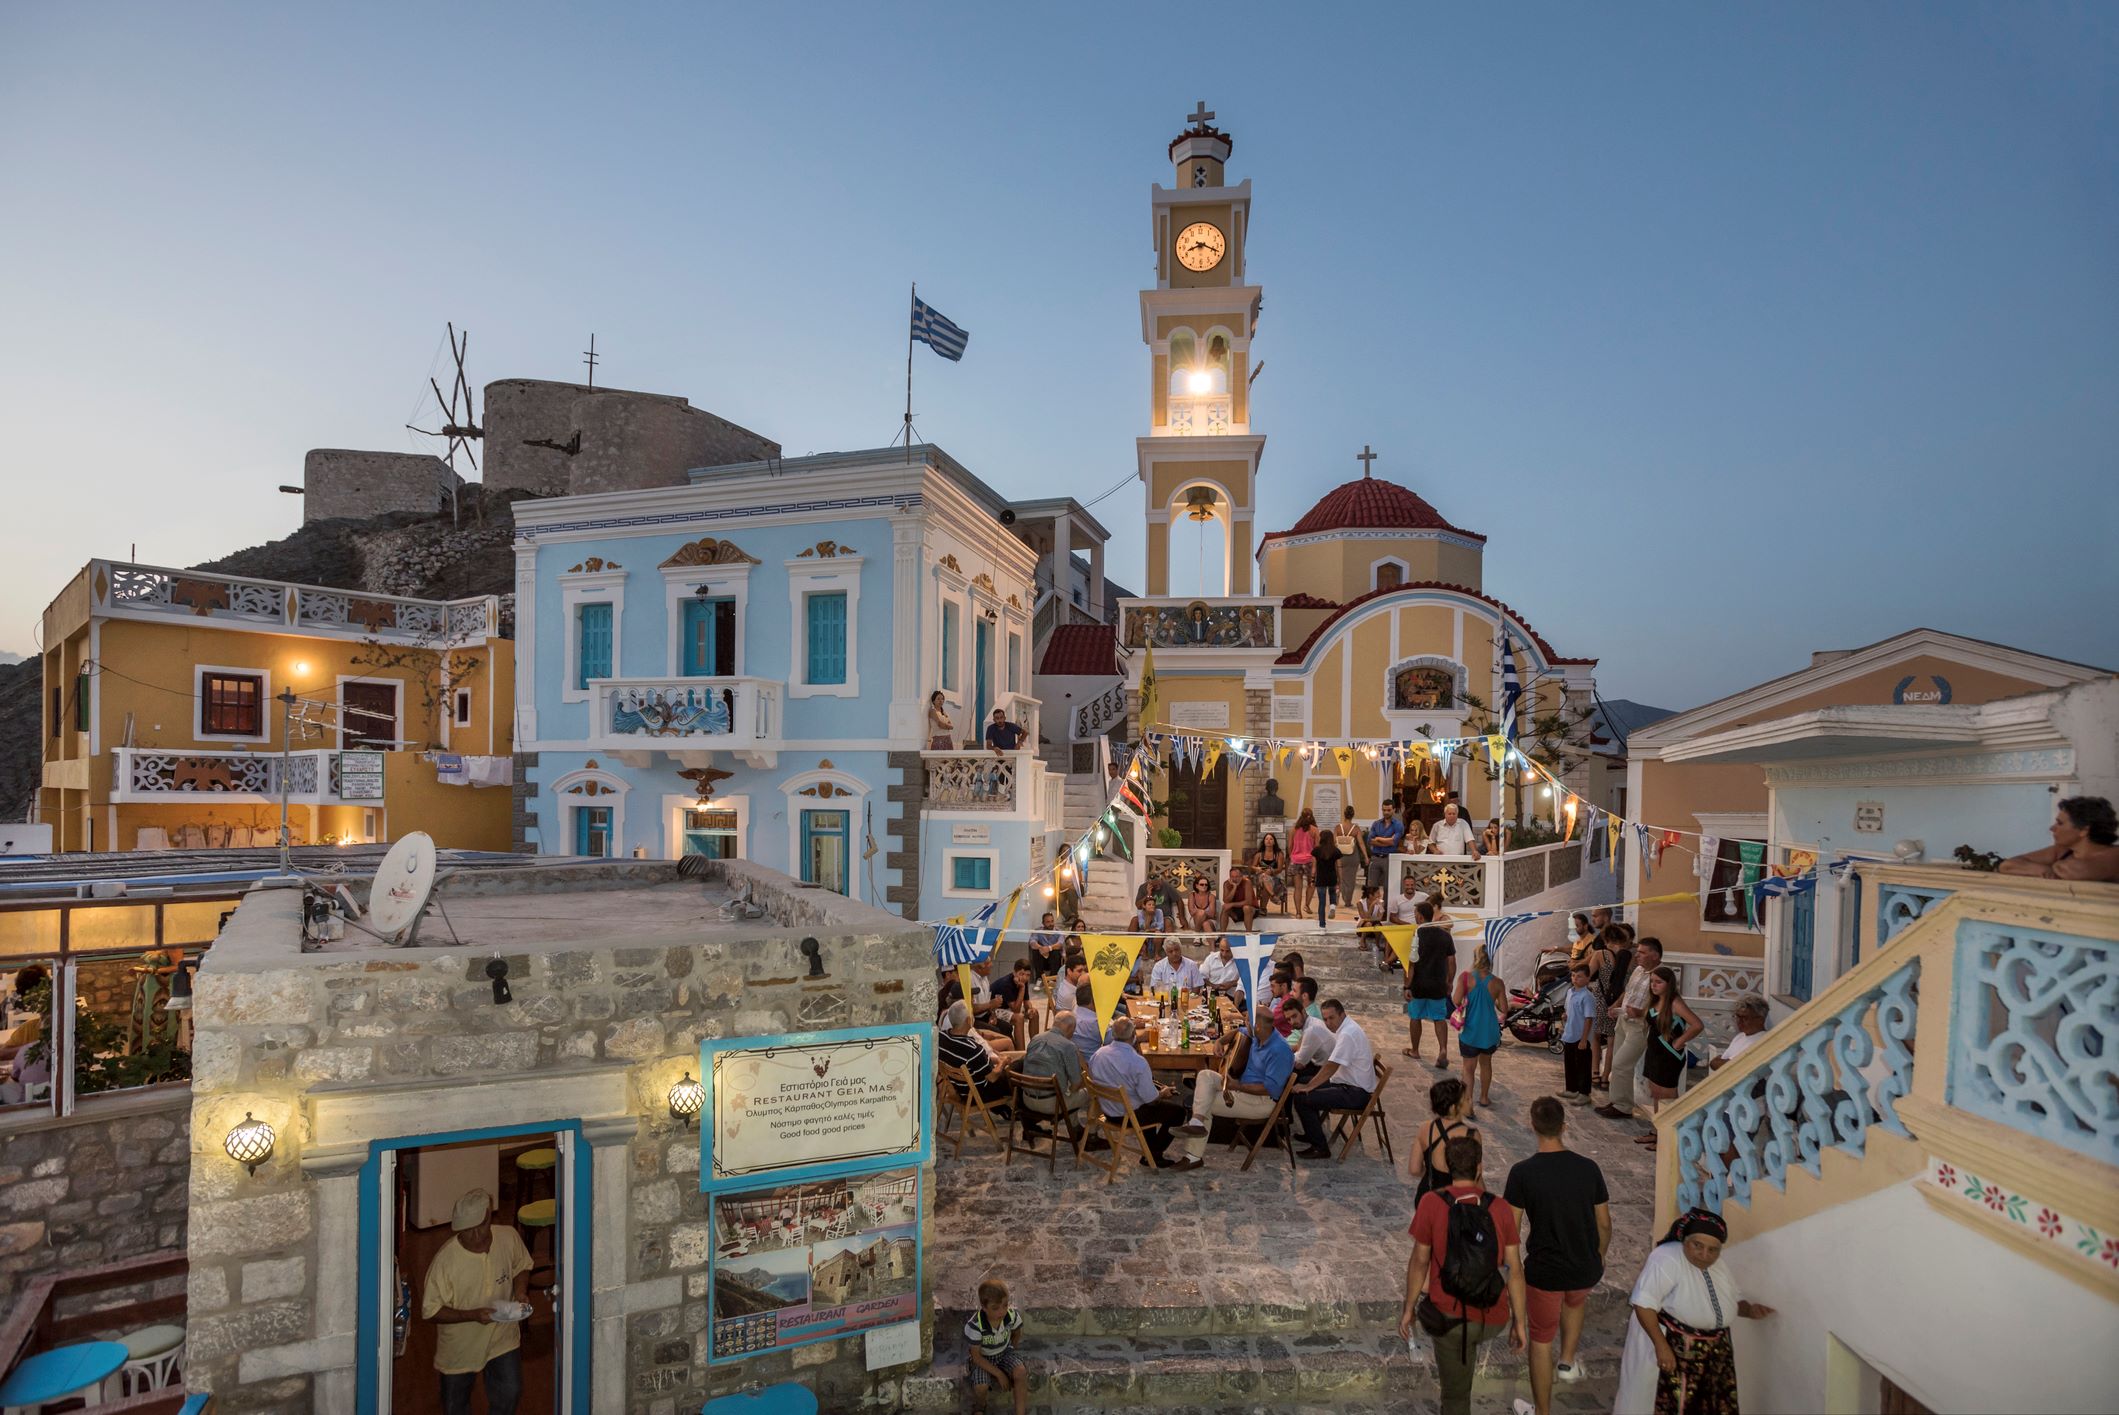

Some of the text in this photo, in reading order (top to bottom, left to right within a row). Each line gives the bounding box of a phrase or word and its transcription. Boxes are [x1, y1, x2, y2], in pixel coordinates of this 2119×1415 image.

[780, 1076, 867, 1092] Εστιατόριο Γειά μας
[753, 1084, 894, 1106] RESTAURANT GEIA MAS
[824, 1099, 858, 1109] Olympos
[859, 1095, 897, 1105] Karpathos
[770, 1118, 802, 1129] Νόστιμο
[803, 1114, 832, 1126] φαγητό
[833, 1112, 856, 1121] καλές
[780, 1123, 866, 1140] Good food good prices
[779, 1307, 847, 1329] RESTAURANT
[856, 1298, 899, 1314] GARDEN
